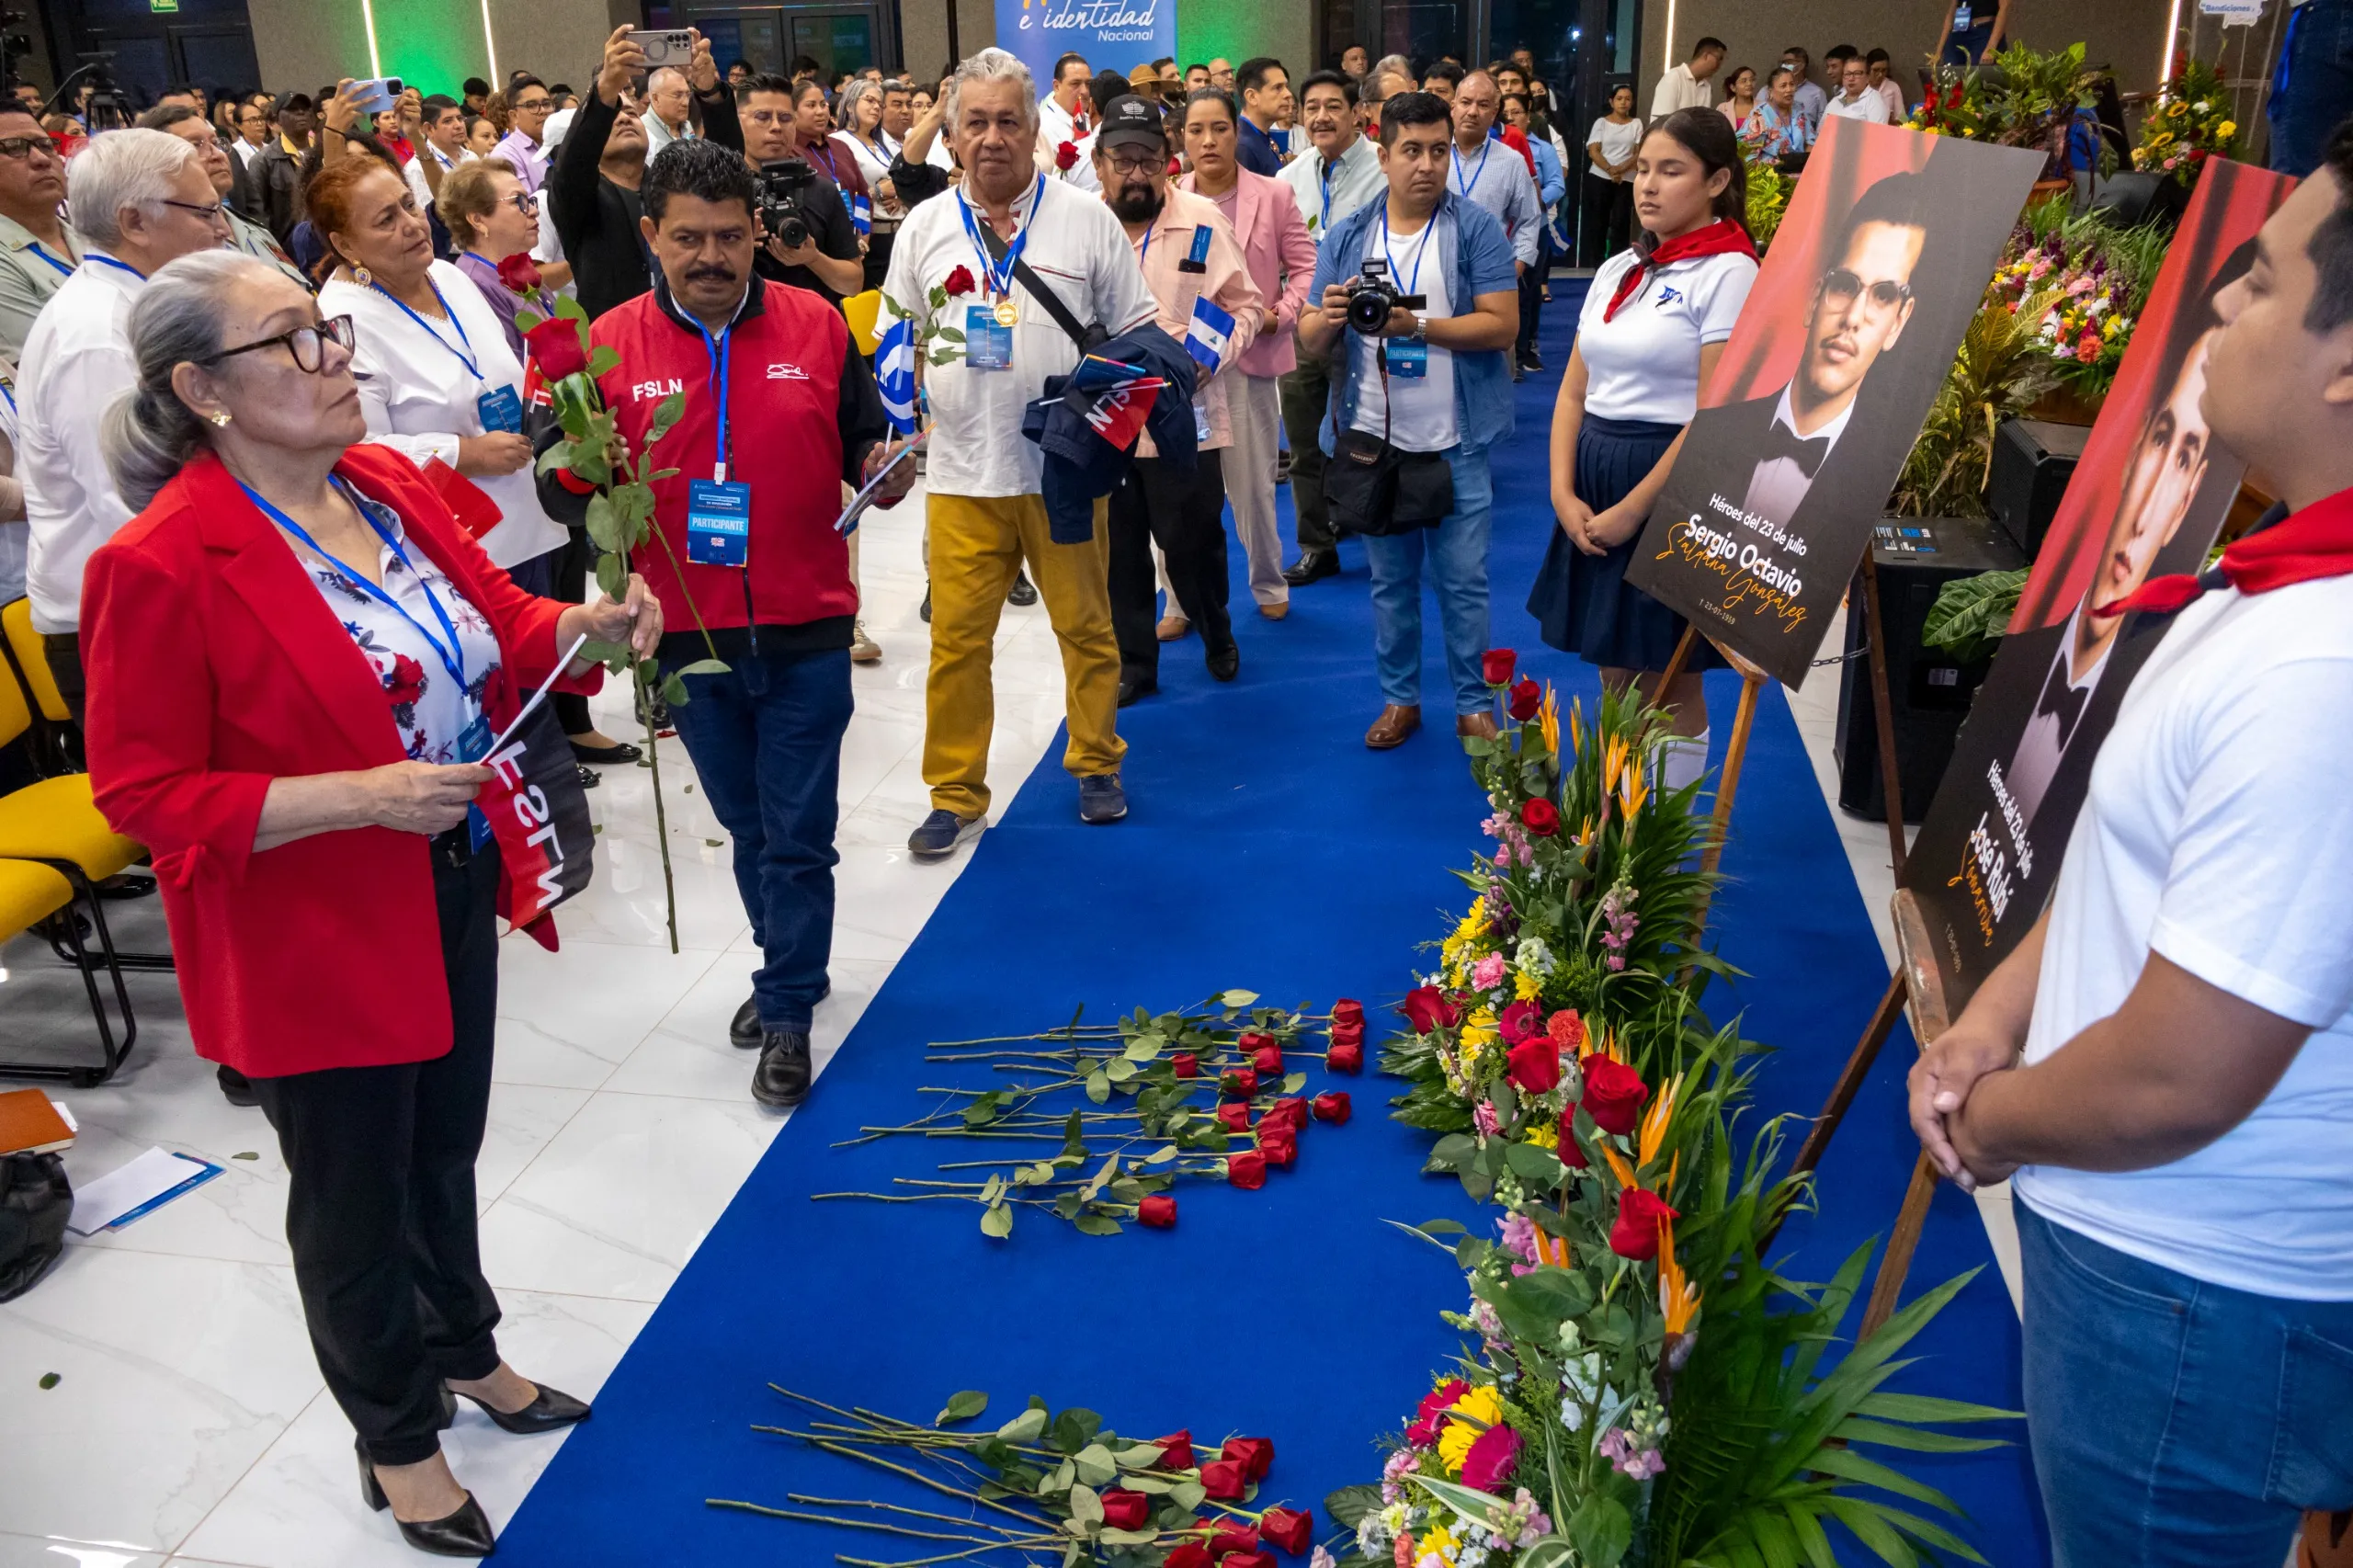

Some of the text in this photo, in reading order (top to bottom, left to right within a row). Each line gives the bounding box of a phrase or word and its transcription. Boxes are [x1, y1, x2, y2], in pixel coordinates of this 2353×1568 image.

[1019, 15, 1033, 29] e
[1042, 0, 1155, 29] identidad
[1097, 29, 1154, 41] Nacional
[632, 378, 684, 402] FSLN
[692, 517, 745, 531] PARTICIPANTE
[1709, 493, 1807, 556] Héroes del 23 de julio
[1684, 514, 1802, 597] Sergio Octavio
[1655, 522, 1808, 634] Saldaña González
[1704, 602, 1736, 626] 23-07-1959
[1986, 758, 2009, 808] Héroes
[2003, 799, 2018, 825] del
[2010, 812, 2023, 840] 23
[2015, 829, 2028, 857] de
[1971, 810, 2015, 924] José Rubí
